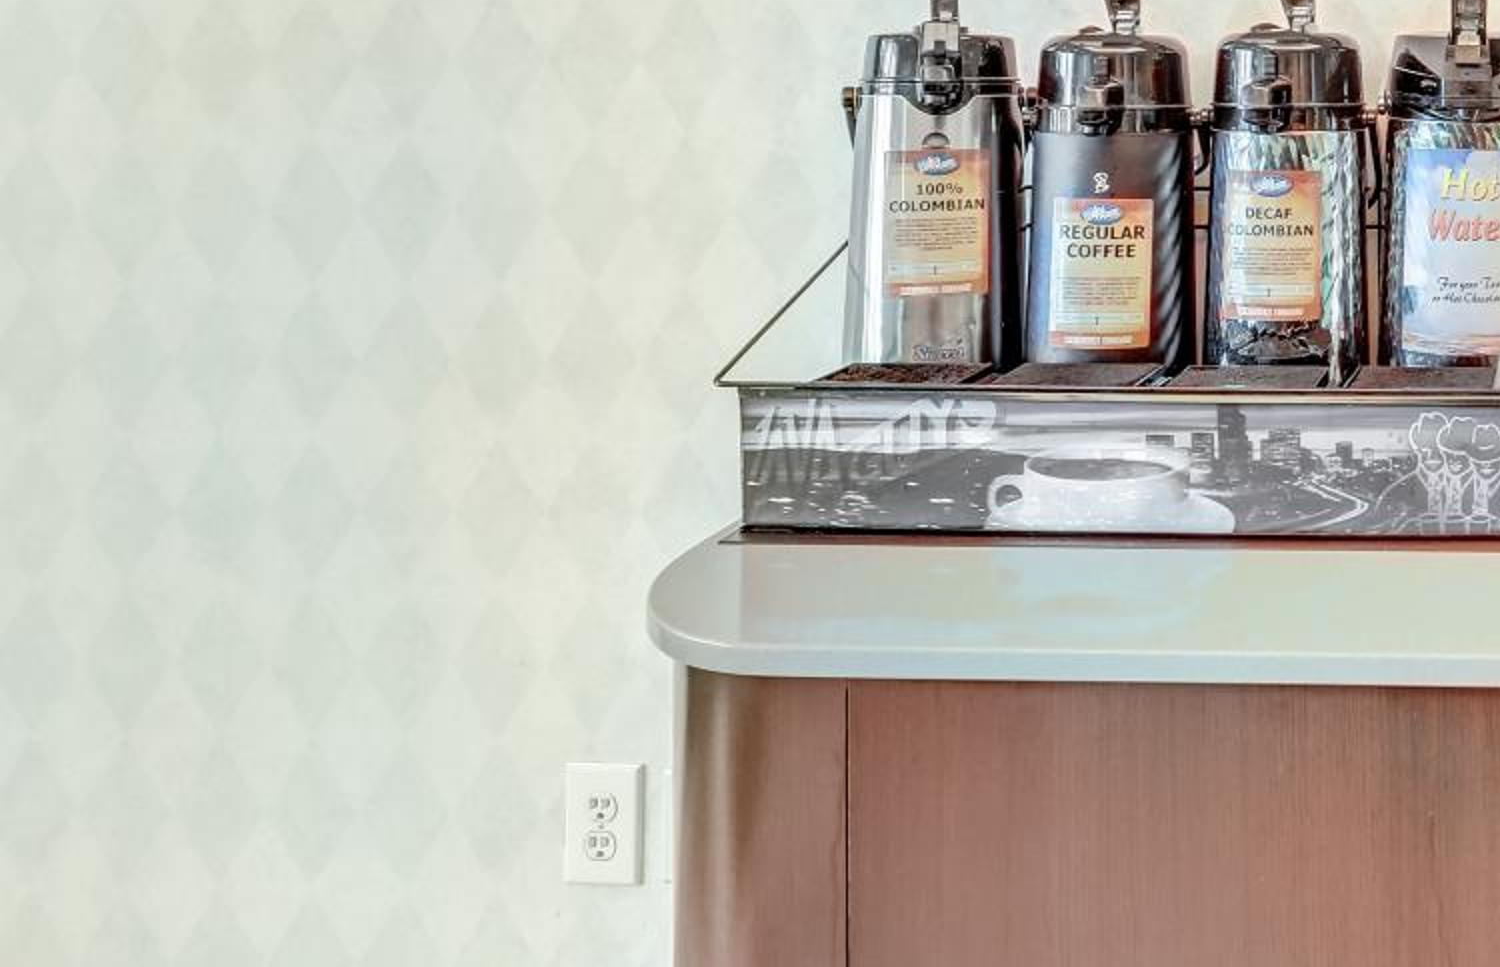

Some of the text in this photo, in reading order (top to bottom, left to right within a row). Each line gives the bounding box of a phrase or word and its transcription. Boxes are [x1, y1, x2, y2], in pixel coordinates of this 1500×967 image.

[916, 183, 964, 195] 100%
[889, 199, 985, 213] COLOMBIAN
[1245, 207, 1292, 220] DECAF
[1060, 224, 1145, 240] REGULAR
[1228, 223, 1314, 237] COLOMBIAN
[1067, 244, 1137, 258] COFFEE
